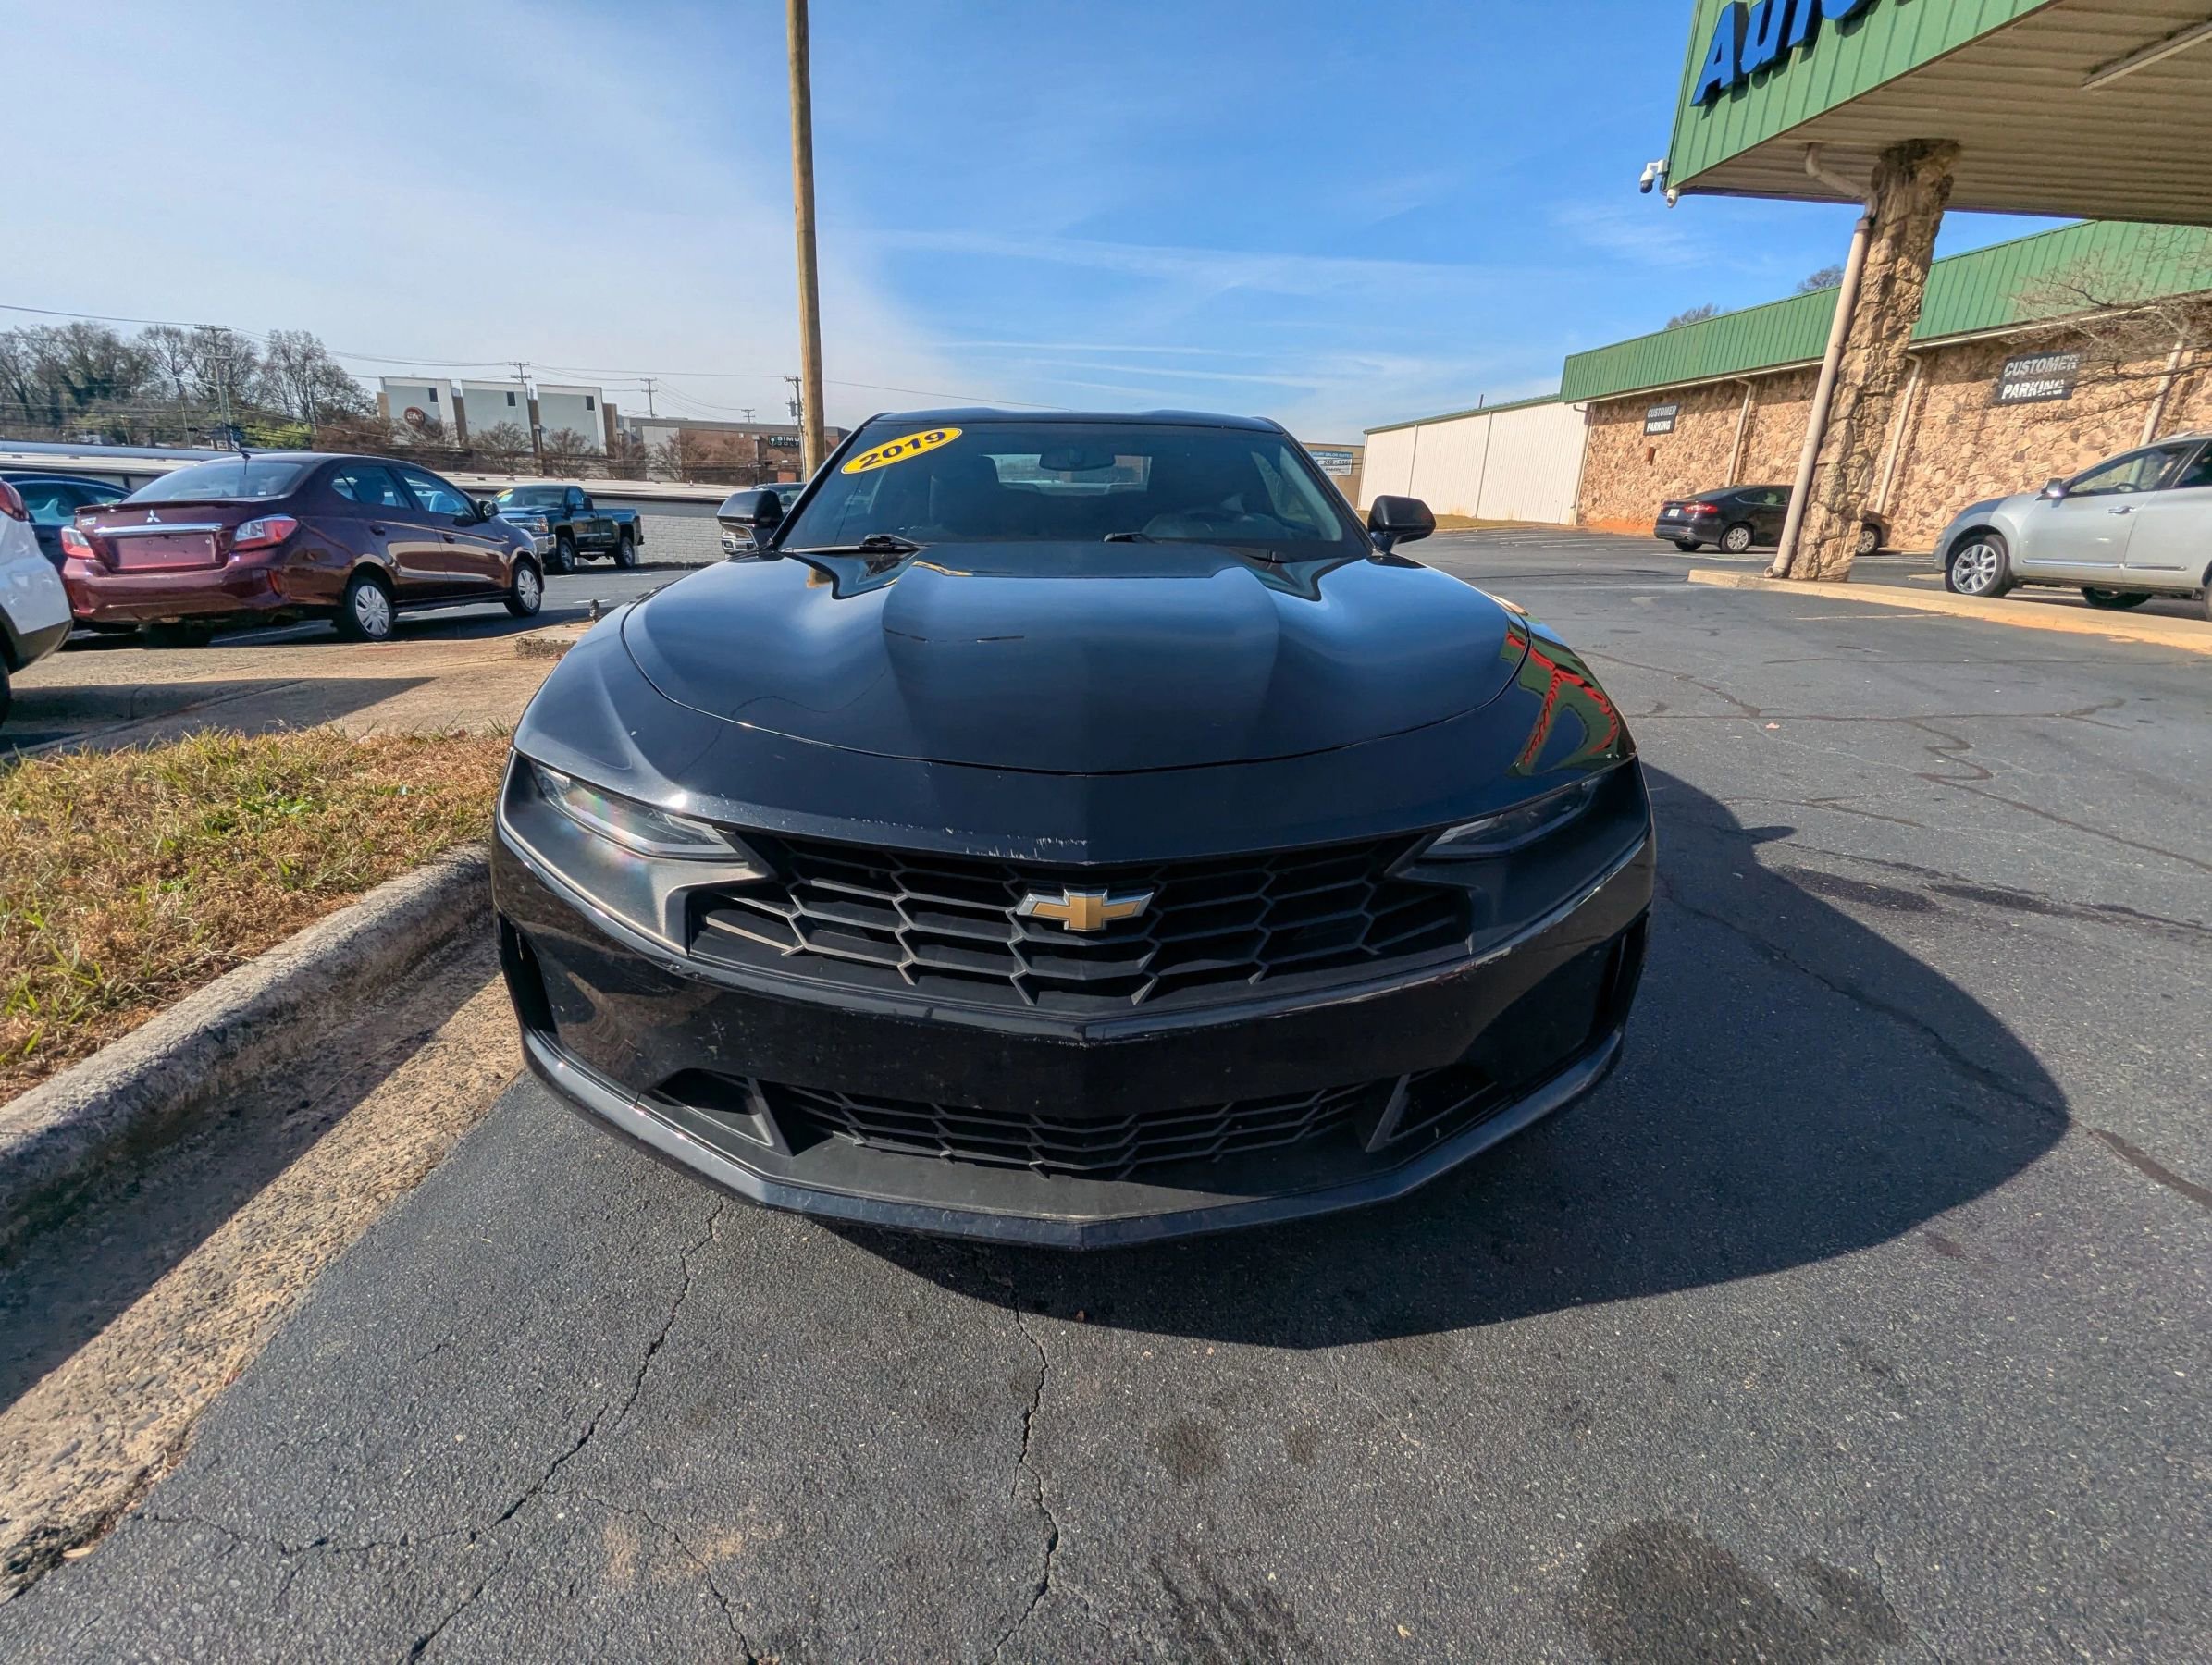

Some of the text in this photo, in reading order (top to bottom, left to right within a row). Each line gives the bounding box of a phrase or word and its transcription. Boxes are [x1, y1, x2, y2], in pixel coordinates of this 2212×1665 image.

[1689, 0, 1860, 106] AU
[2003, 354, 2081, 377] CUSTOMER
[2001, 379, 2065, 400] PARKING
[1647, 405, 1677, 418] CUSTOMER
[1646, 420, 1672, 432] PARKING
[859, 431, 945, 469] 2019
